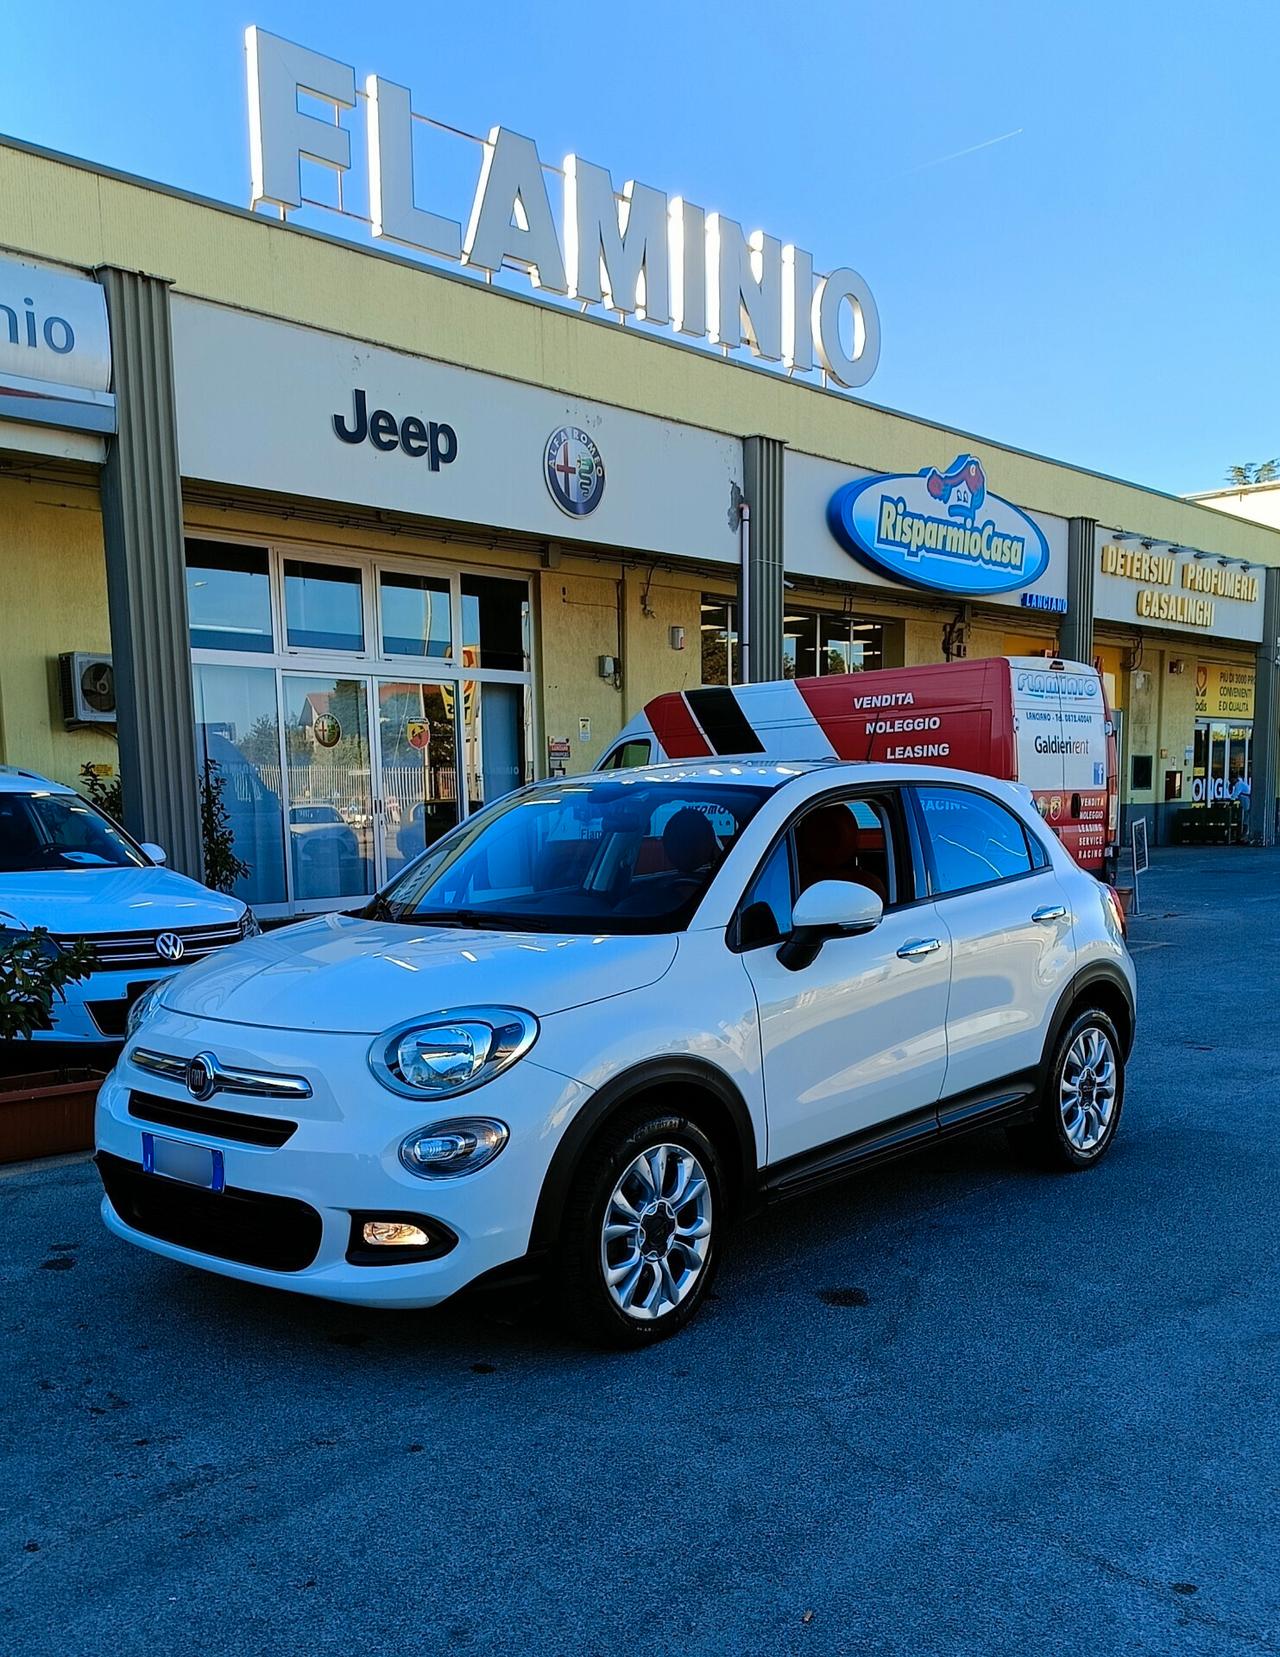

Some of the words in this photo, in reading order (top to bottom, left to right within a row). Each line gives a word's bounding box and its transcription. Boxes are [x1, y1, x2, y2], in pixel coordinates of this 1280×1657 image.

[243, 24, 881, 388] FLAMINIO
[332, 387, 458, 473] Jeep
[548, 431, 568, 469] ALFA
[572, 429, 604, 477] ROMEO
[1101, 545, 1175, 586] DETERSIVI
[1182, 563, 1259, 602] PROFUMERIA
[1021, 593, 1068, 613] LANCIANO
[1137, 590, 1216, 628] CASALINGHI
[853, 692, 914, 710] VENDITA
[1026, 711, 1051, 721] LANCIANO
[865, 716, 941, 735] NOLEGGIO
[886, 743, 950, 760] LEASING
[1080, 797, 1104, 807] VENDITA
[1079, 810, 1104, 820] NOLEGGIO
[1078, 824, 1102, 833] LEASING
[1079, 836, 1103, 846] SERVICE
[1078, 849, 1102, 859] RACING
